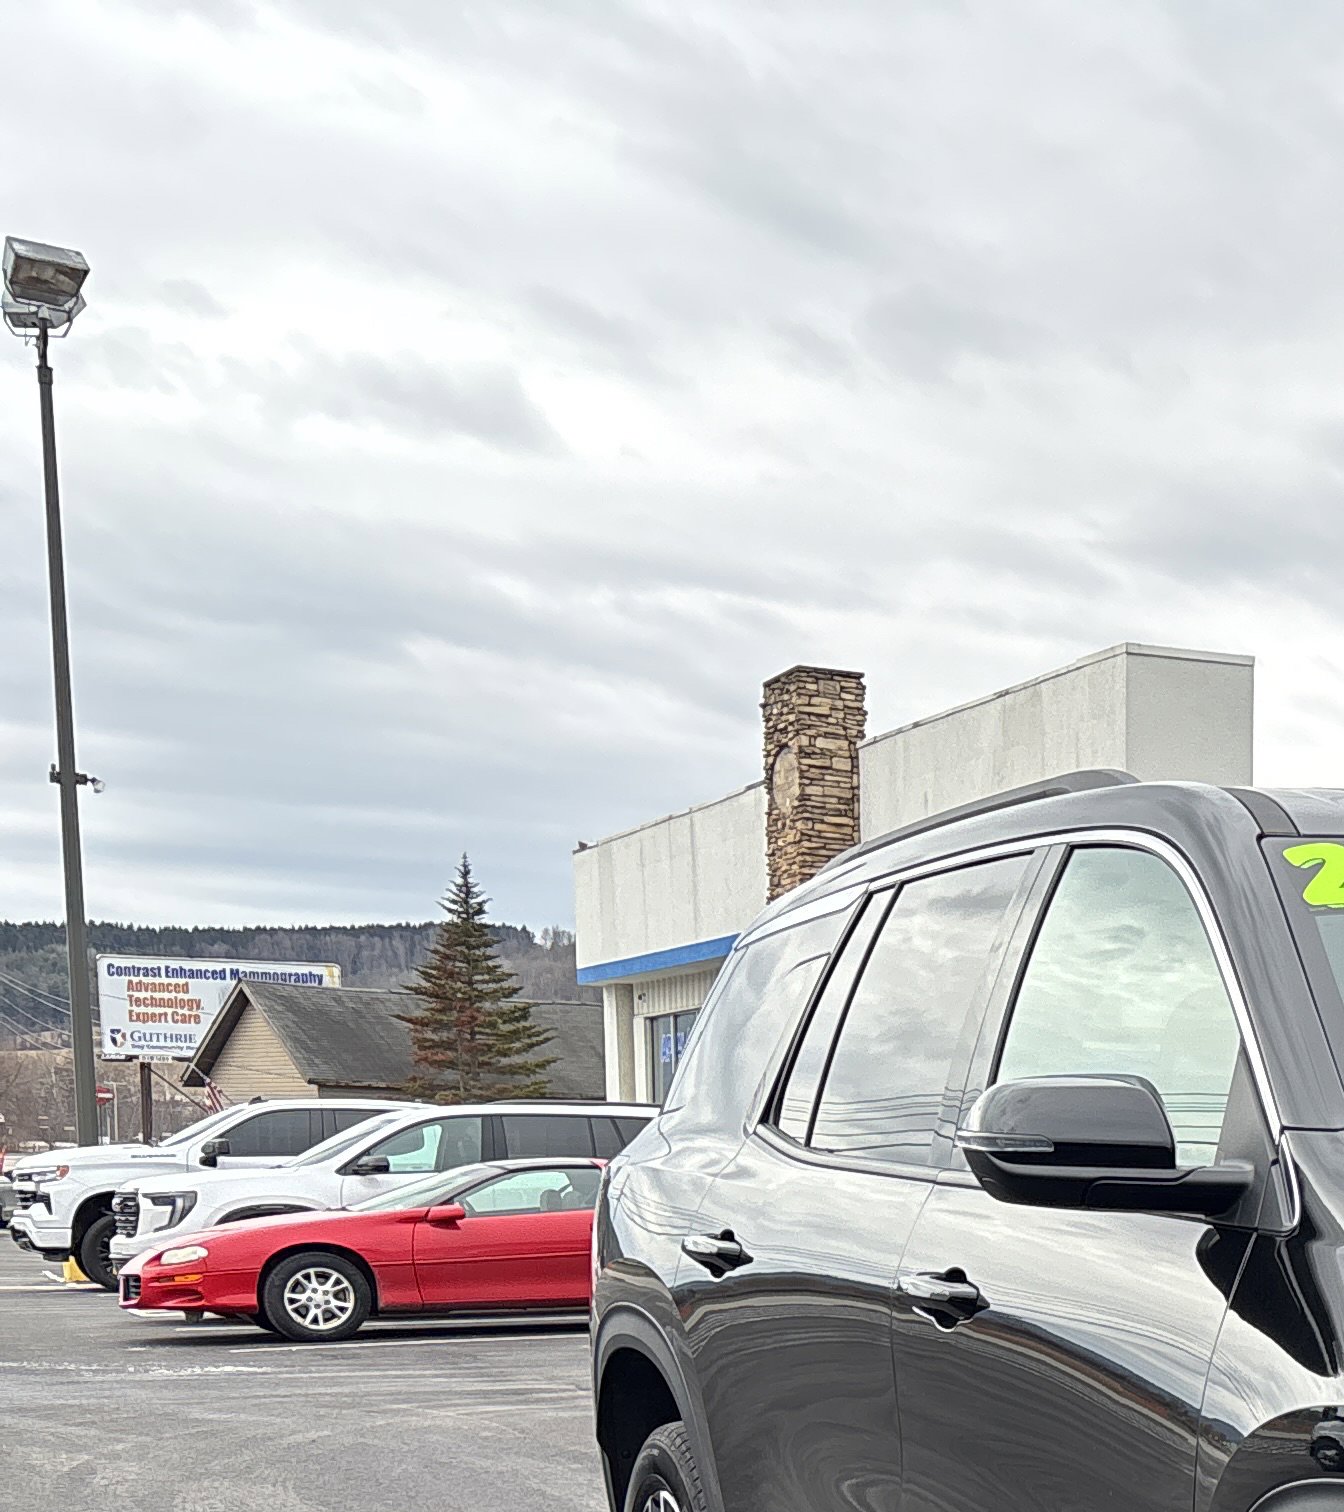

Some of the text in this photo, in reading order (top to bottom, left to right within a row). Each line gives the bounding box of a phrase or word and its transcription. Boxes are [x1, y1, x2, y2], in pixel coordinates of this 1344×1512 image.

[107, 963, 162, 978] Contrast
[165, 965, 227, 981] Enhanced
[127, 979, 190, 994] Advanced
[128, 1009, 201, 1024] Expert Care
